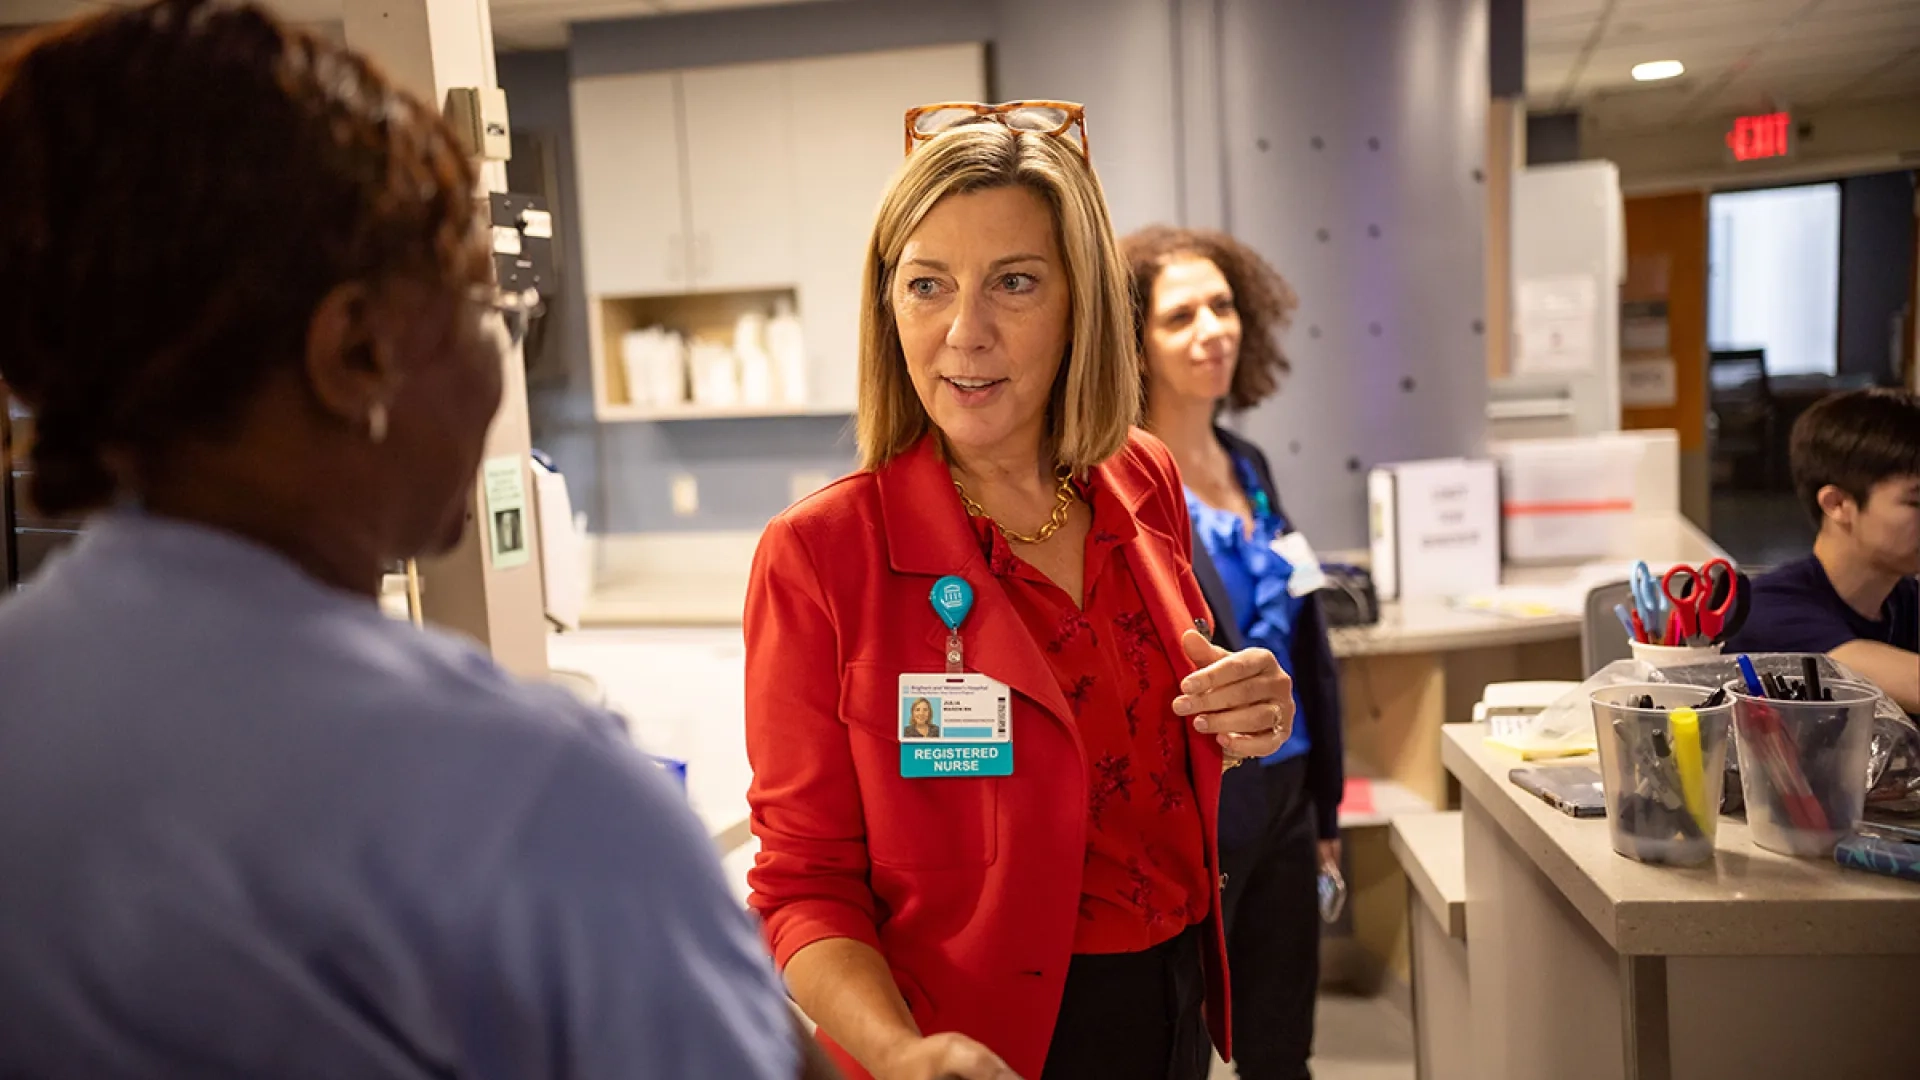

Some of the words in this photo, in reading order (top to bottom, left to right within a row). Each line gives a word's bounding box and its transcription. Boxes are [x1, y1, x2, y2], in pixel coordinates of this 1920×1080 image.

[1735, 112, 1790, 161] EXIT
[914, 747, 999, 760] REGISTERED
[933, 760, 980, 772] NURSE
